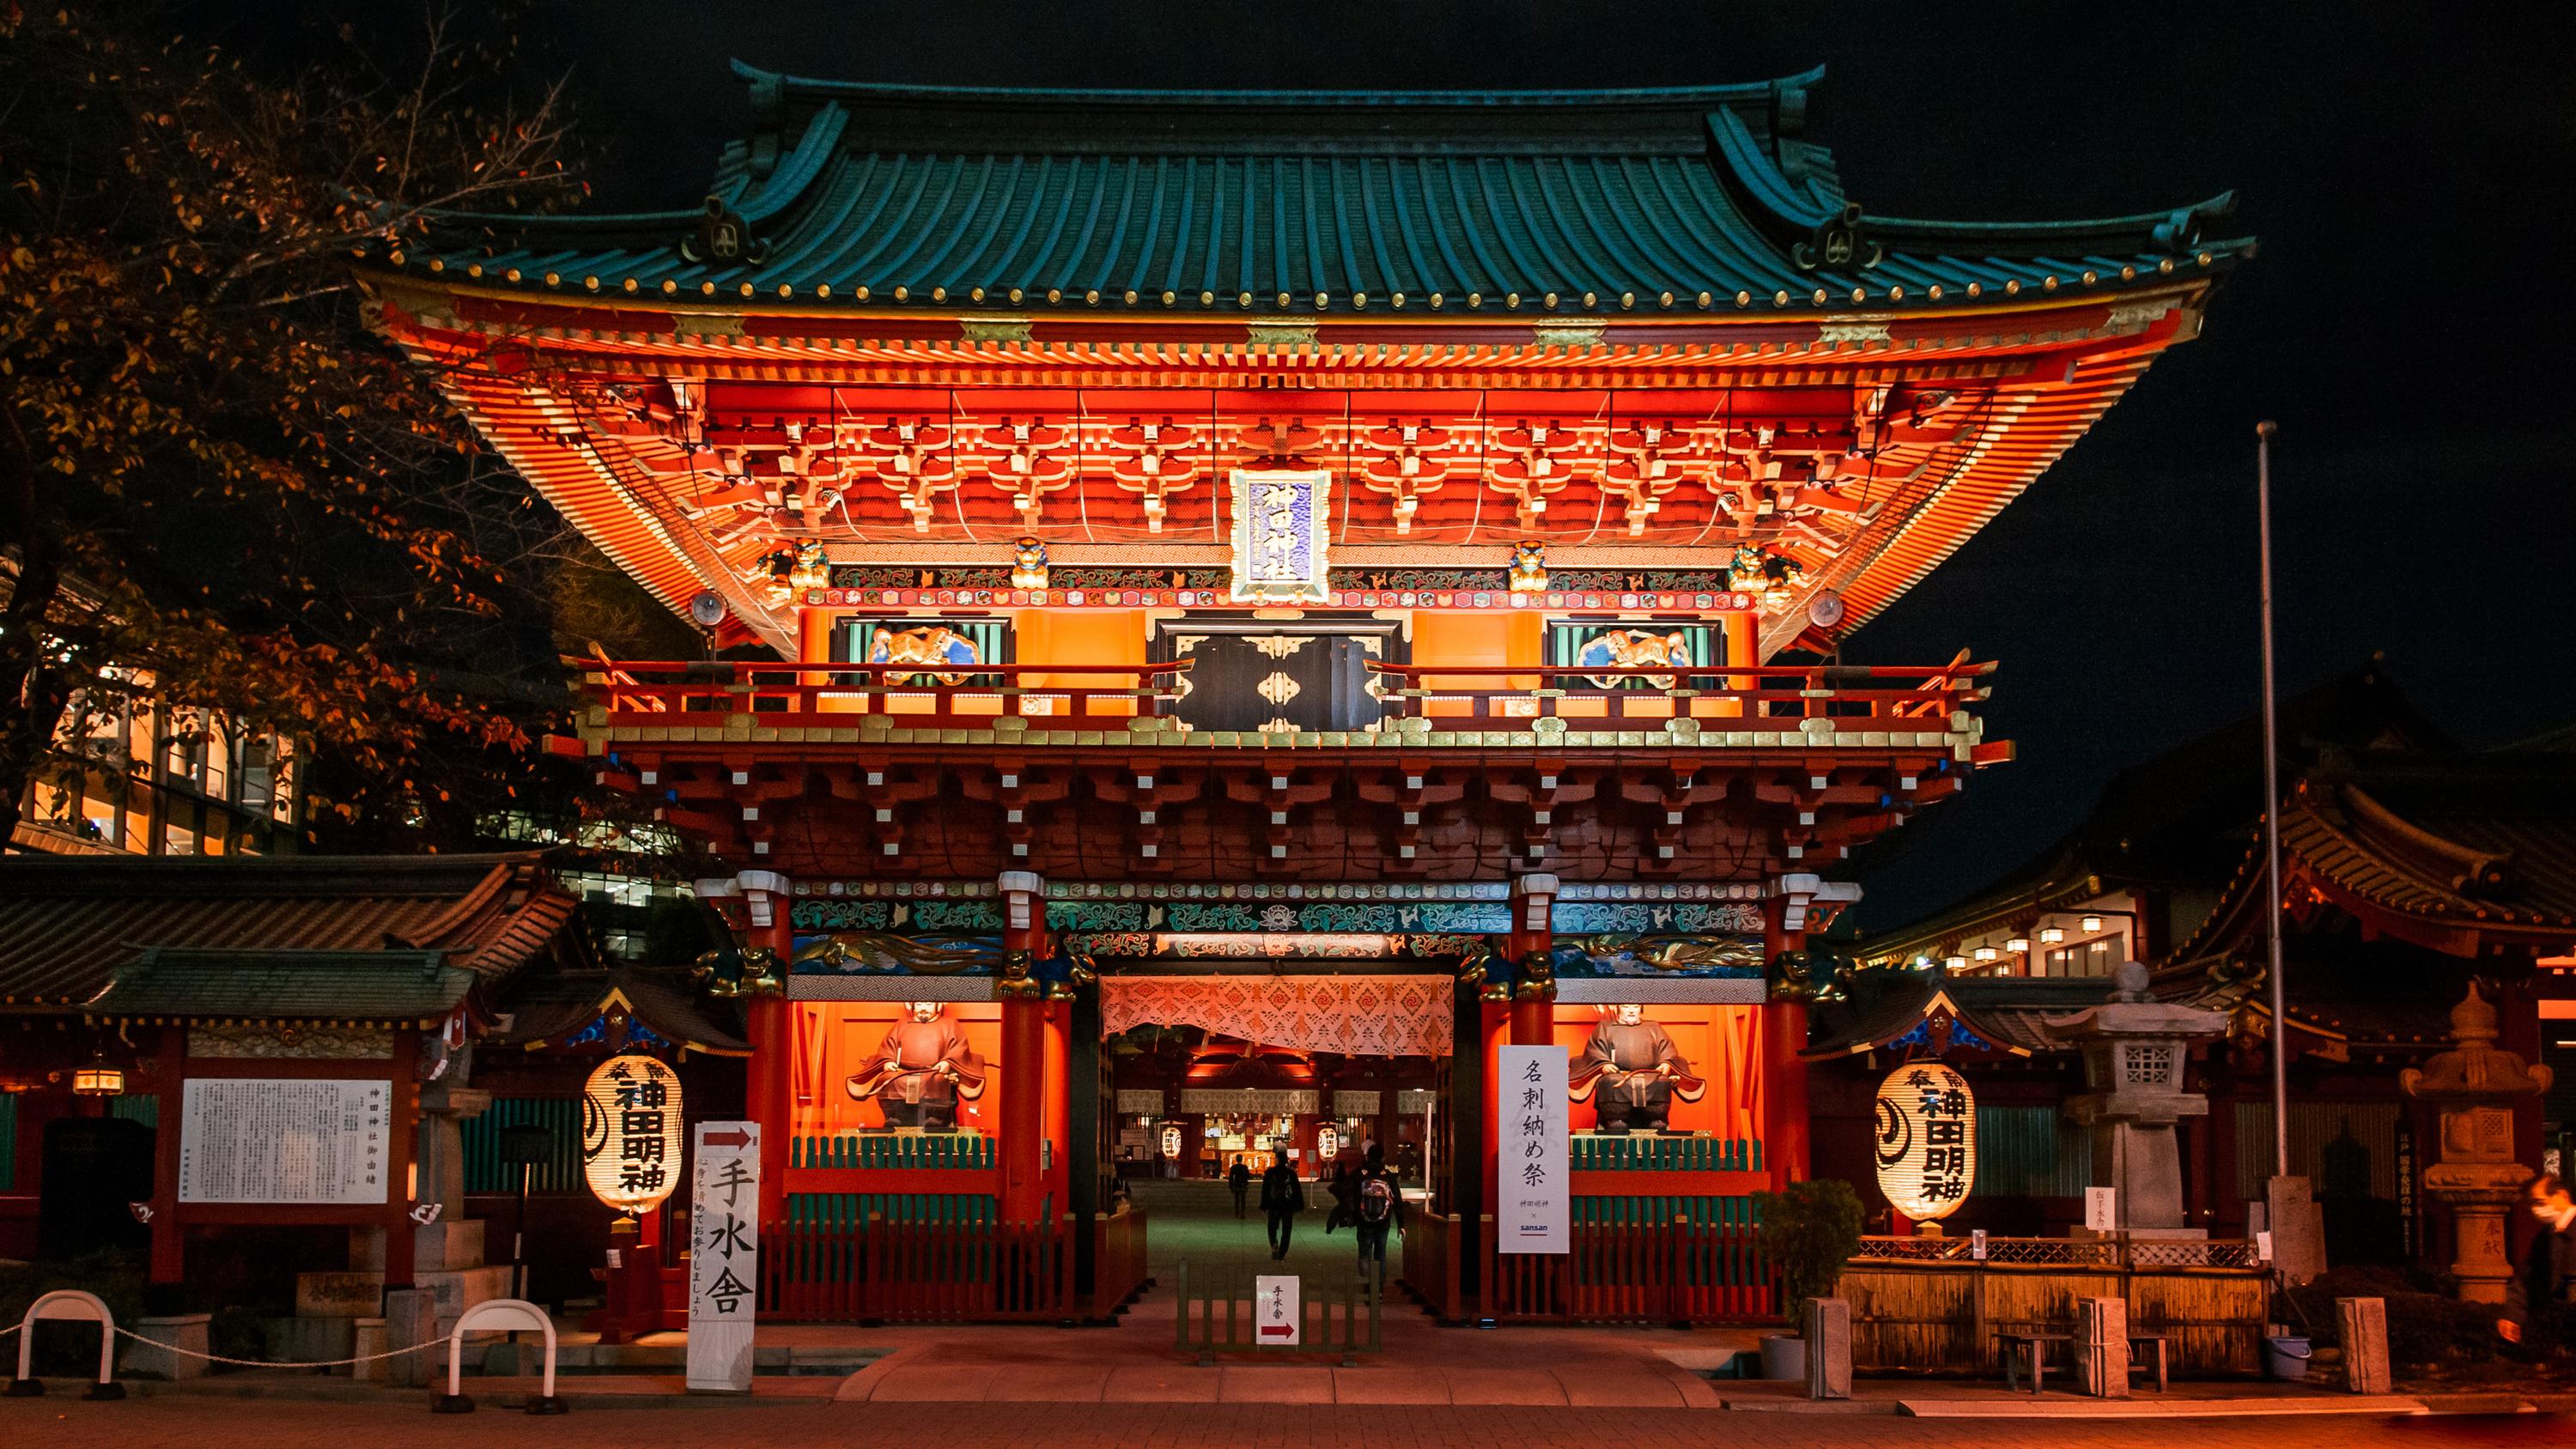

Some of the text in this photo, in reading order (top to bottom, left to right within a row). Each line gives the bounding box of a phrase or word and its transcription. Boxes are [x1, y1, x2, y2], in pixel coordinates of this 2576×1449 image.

[614, 1080, 667, 1192] 神田明神
[1521, 1059, 1546, 1187] 名刺納め祭
[1917, 1088, 1966, 1203] 神田明神
[705, 1158, 756, 1314] 手水舎
[1273, 1285, 1284, 1319] 手水舎
